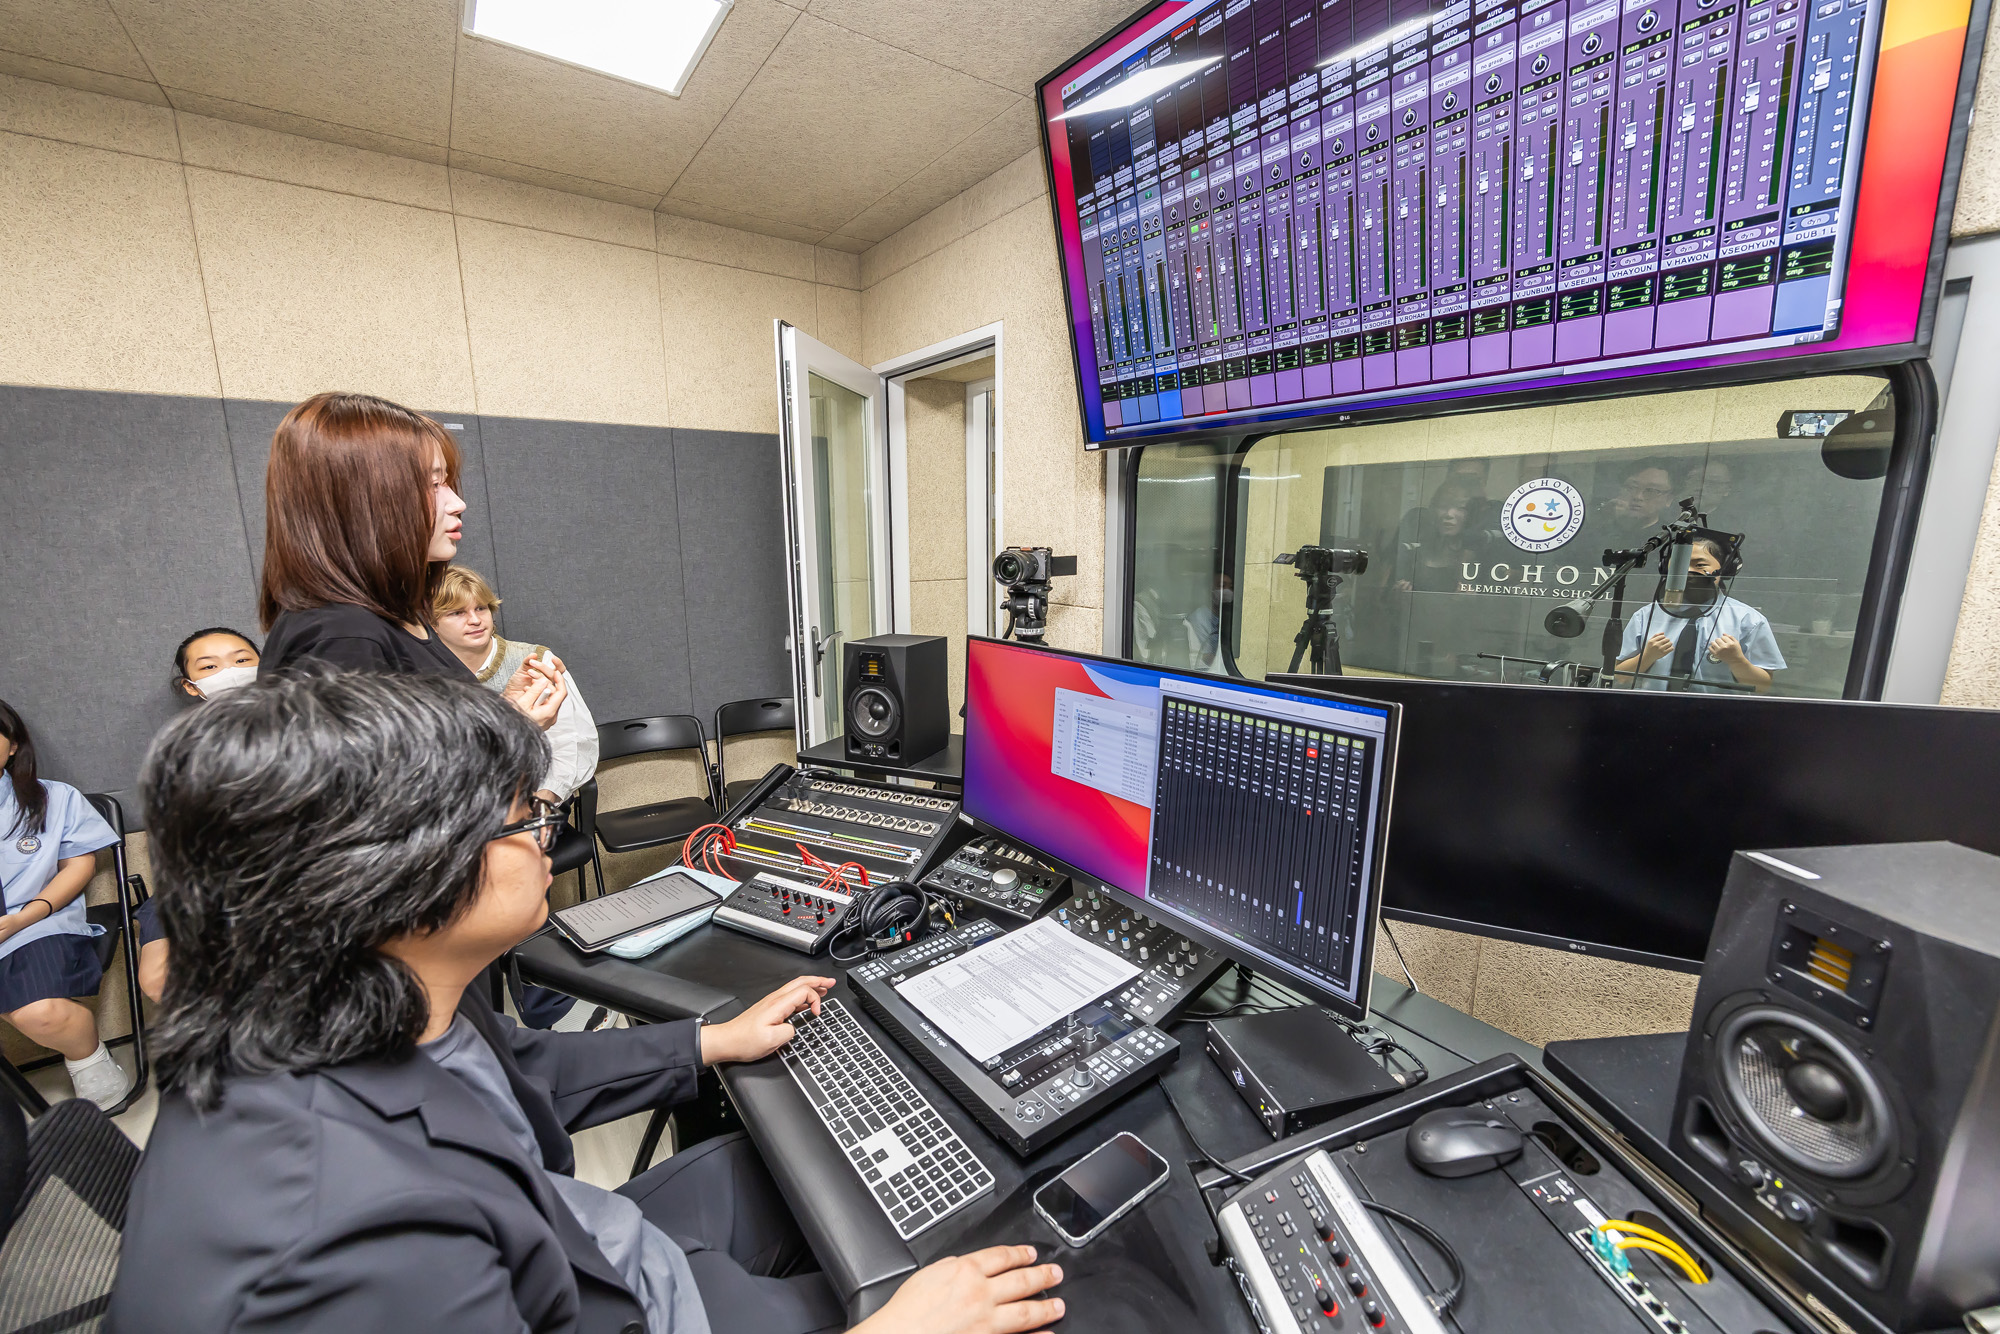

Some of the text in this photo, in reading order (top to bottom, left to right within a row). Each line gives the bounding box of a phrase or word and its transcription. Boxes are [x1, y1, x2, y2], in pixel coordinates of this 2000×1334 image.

[1487, 7, 1503, 19] AUTO
[1685, 21, 1700, 31] pan
[1443, 28, 1458, 39] AUTO
[1402, 48, 1417, 58] AUTO
[1626, 44, 1640, 54] pan
[1365, 66, 1379, 76] AUTO
[1572, 65, 1585, 76] pan
[1522, 84, 1535, 95] pan
[1476, 102, 1489, 112] pan
[1796, 205, 1811, 215] 0.0
[1730, 220, 1744, 230] 0.0
[1671, 234, 1683, 243] 0.0
[1795, 230, 1818, 241] DUB
[1616, 247, 1627, 256] 0.0
[1566, 259, 1576, 267] 0.0
[1674, 252, 1710, 265] HAWON
[1571, 276, 1598, 287] SEEJIN
[1516, 479, 1573, 496] UCHON
[1502, 501, 1552, 551] ELEMENTARY
[1556, 501, 1583, 545] SCHOOL
[1461, 562, 1617, 587] UCHON
[1460, 583, 1548, 598] ELEMENTARY
